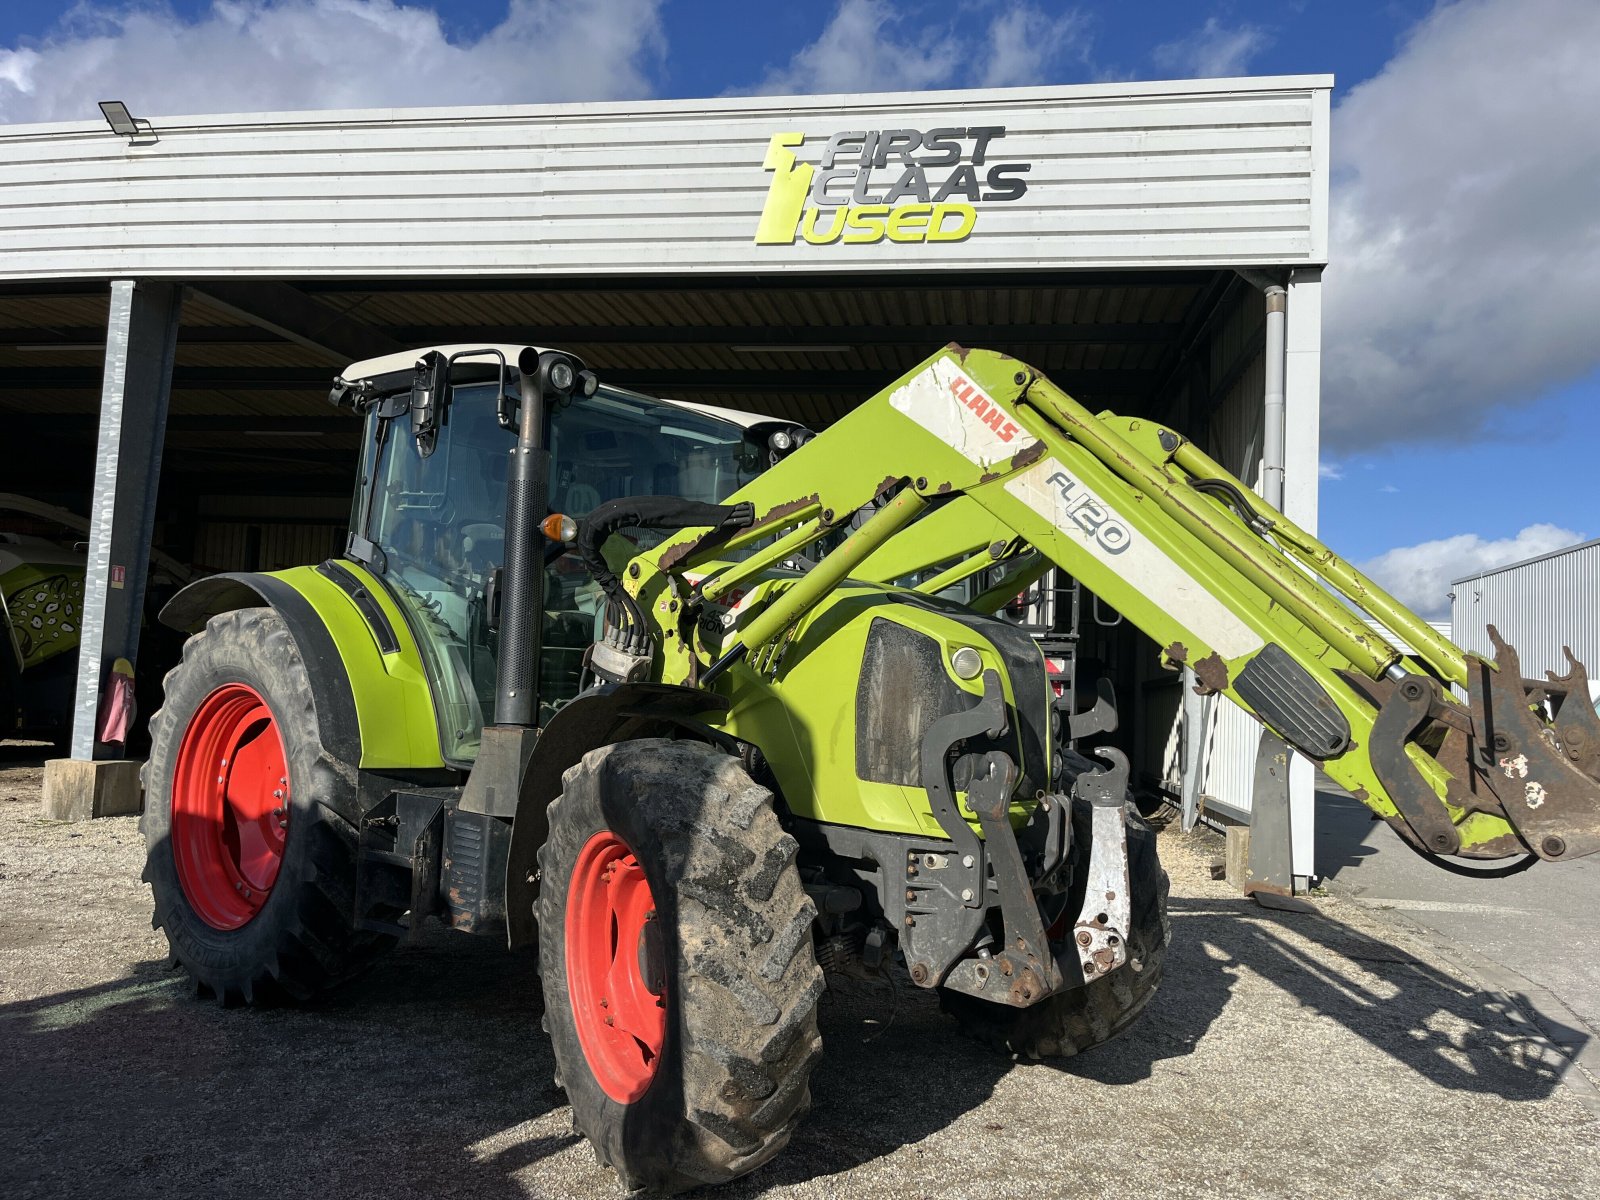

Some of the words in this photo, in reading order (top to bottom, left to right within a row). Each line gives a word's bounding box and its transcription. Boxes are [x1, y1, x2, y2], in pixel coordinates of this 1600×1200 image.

[820, 126, 1006, 167] FIRST
[813, 163, 1032, 205] CLAAS
[802, 204, 978, 243] USED
[950, 376, 1020, 443] CLAAS
[699, 617, 725, 635] RION
